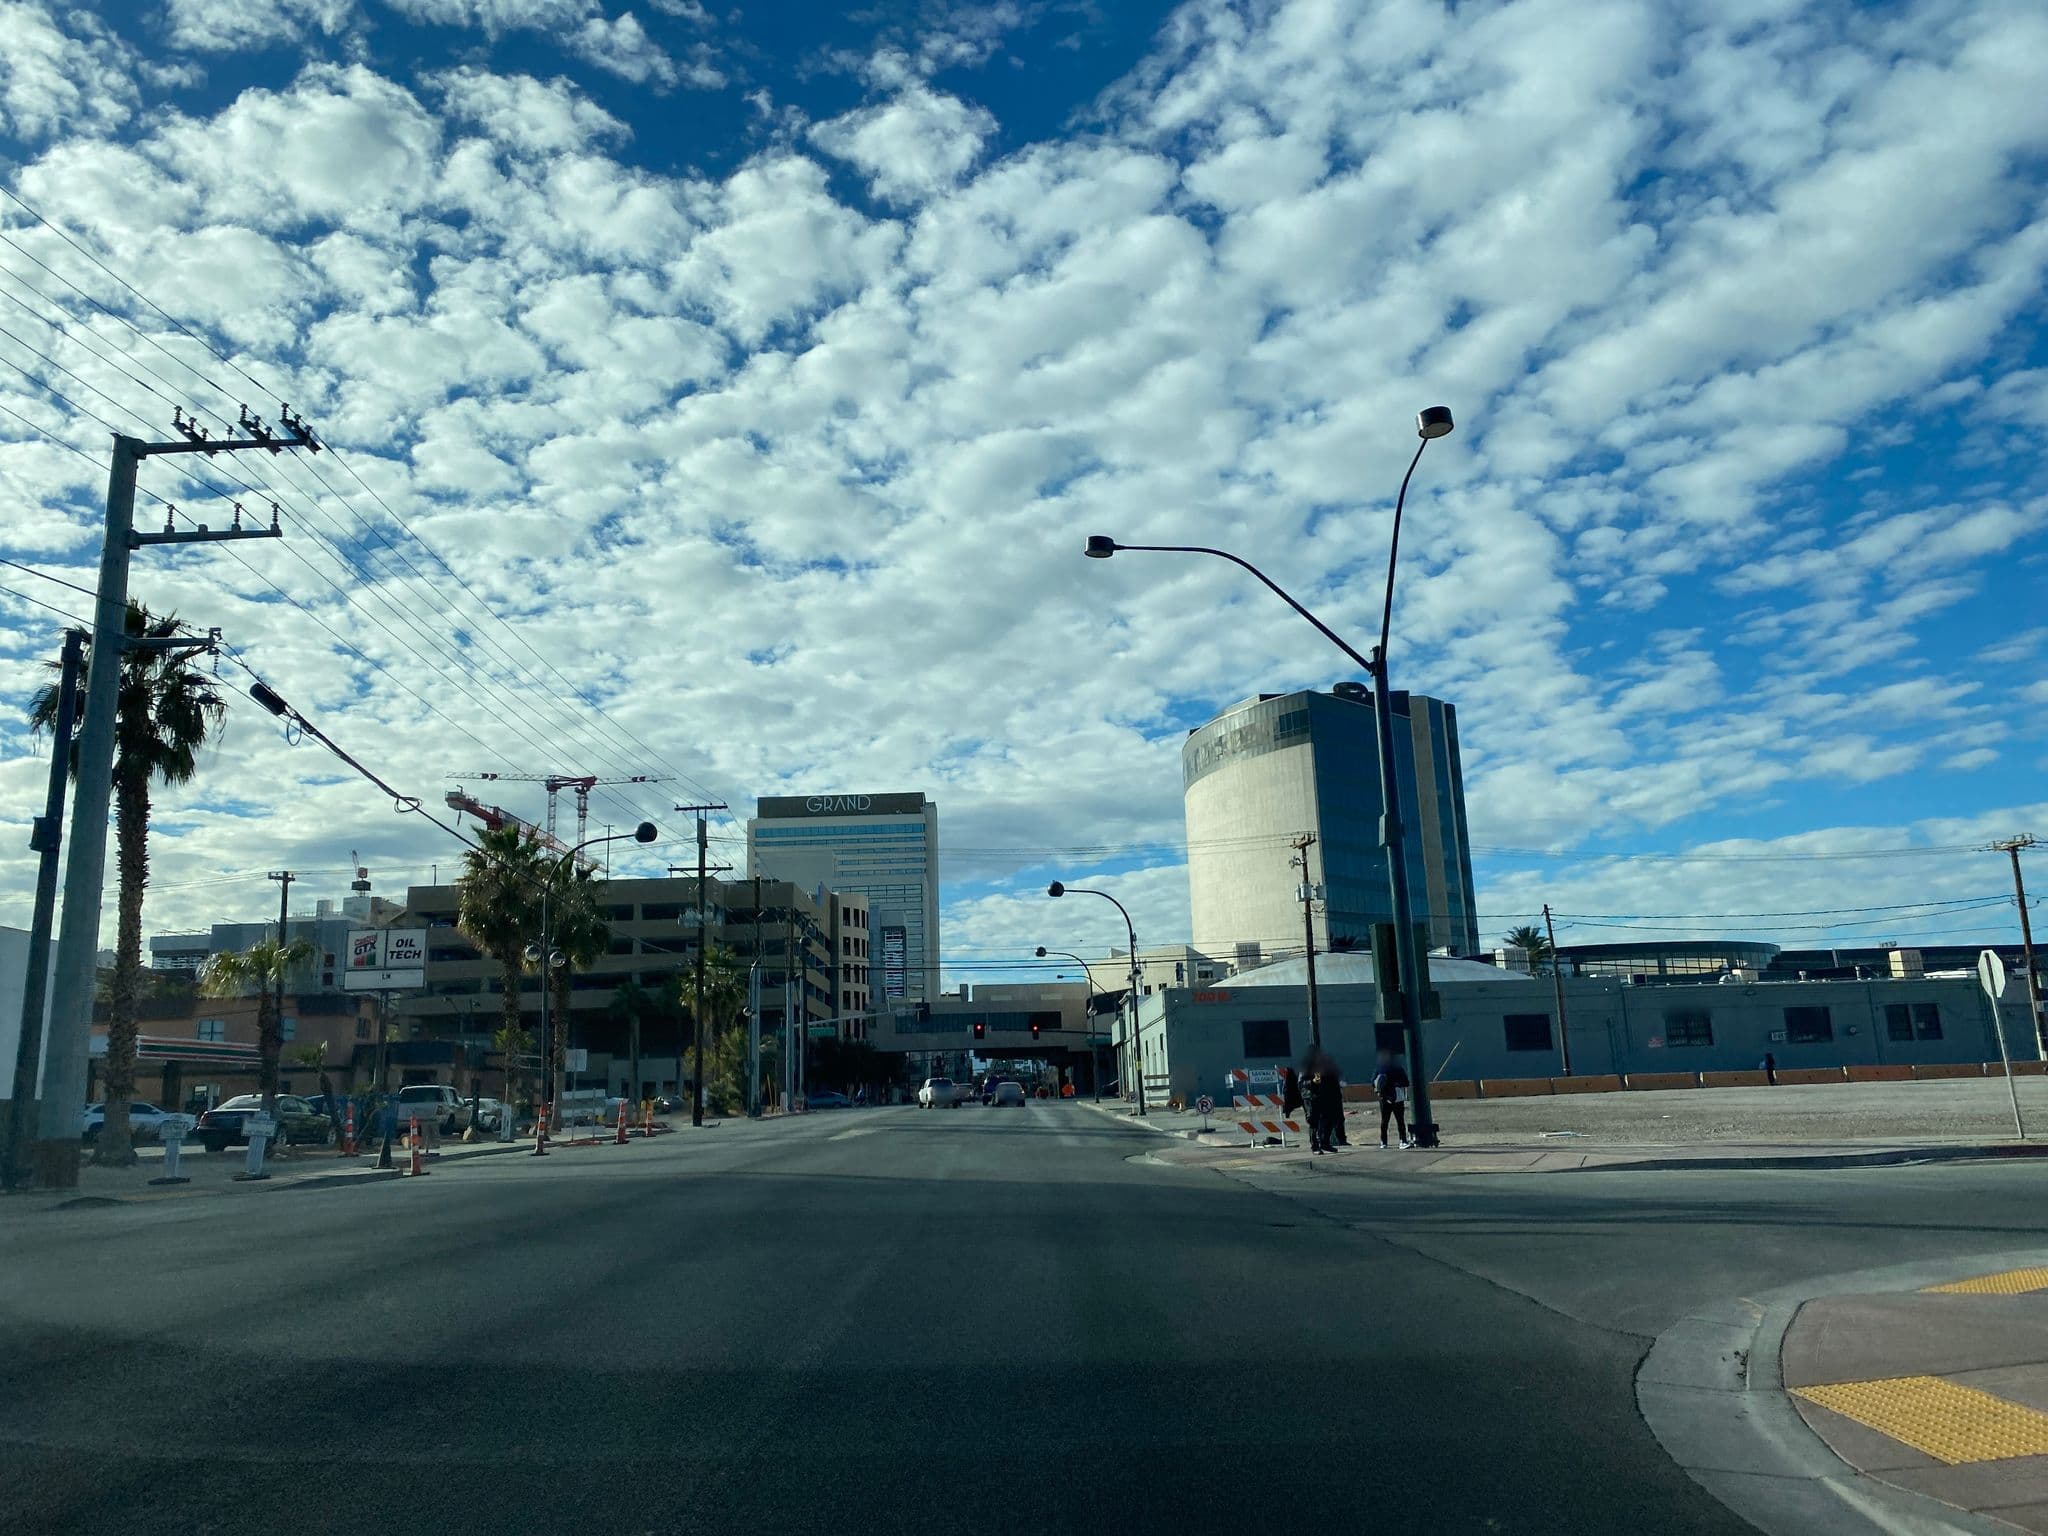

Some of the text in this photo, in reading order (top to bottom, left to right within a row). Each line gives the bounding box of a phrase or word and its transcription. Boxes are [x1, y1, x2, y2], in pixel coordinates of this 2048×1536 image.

[806, 795, 871, 812] GRAND
[354, 941, 377, 955] GTX
[395, 938, 416, 948] OIL
[389, 950, 422, 960] TECH
